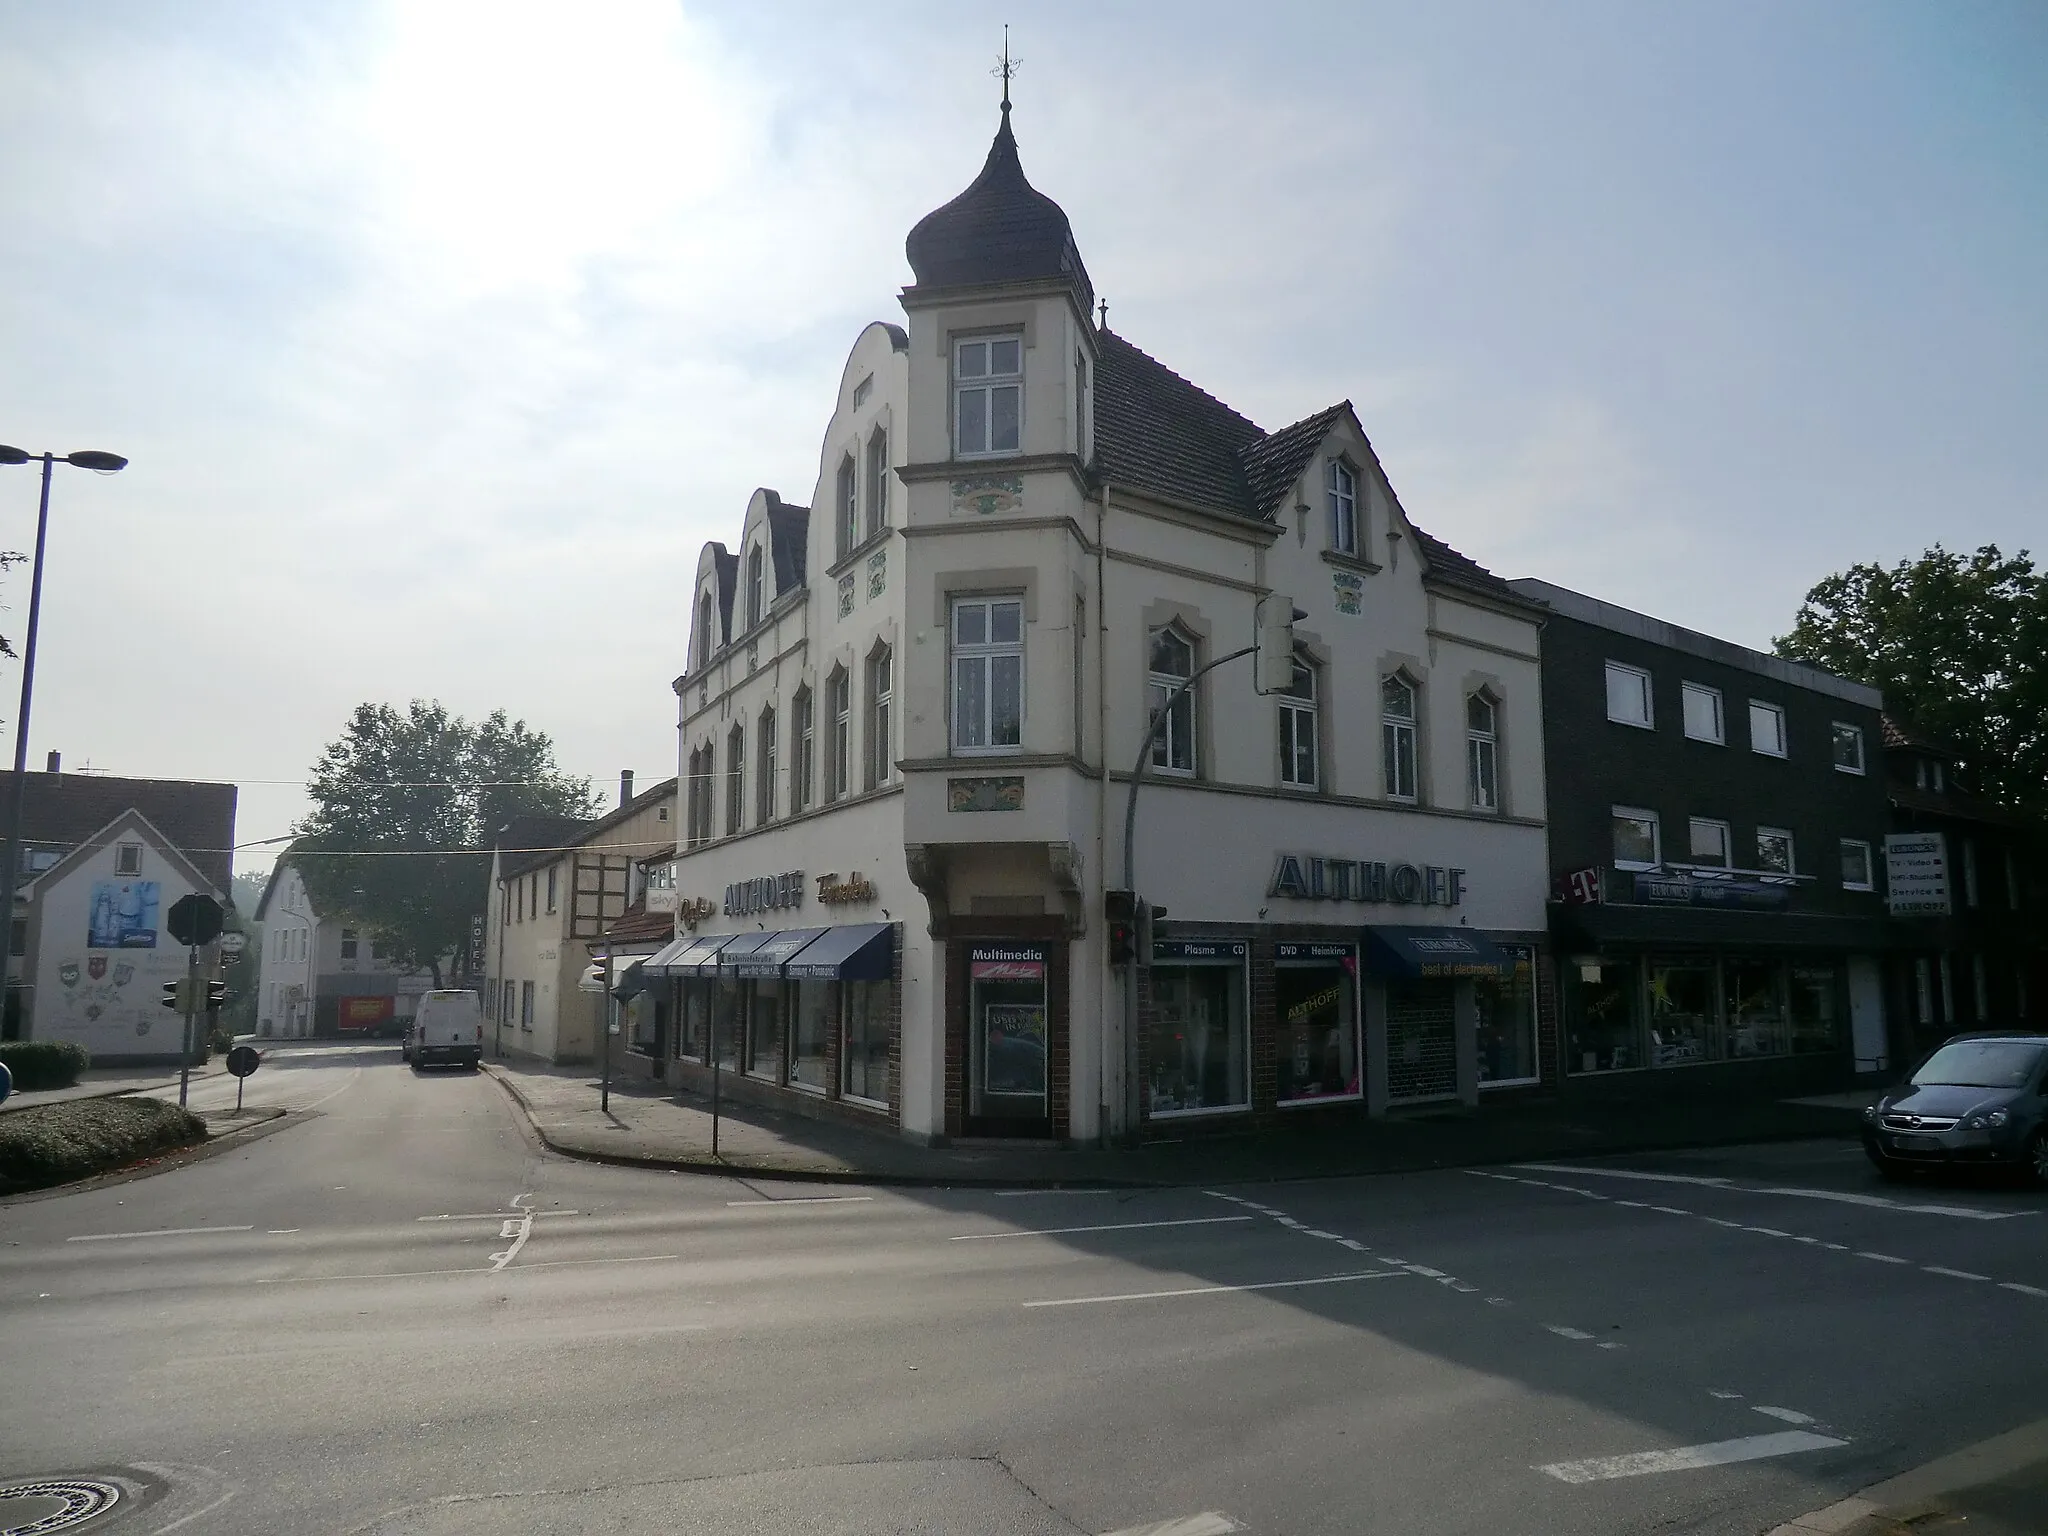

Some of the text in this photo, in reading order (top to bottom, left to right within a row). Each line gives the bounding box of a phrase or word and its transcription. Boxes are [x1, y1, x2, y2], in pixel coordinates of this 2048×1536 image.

[1267, 855, 1466, 907] ALTHOFF
[724, 870, 806, 917] ALTHOFF
[1892, 888, 1932, 896] Service
[651, 895, 672, 909] sky
[472, 915, 483, 972] HOTEL
[1184, 944, 1245, 955] Plasma CD
[1280, 945, 1346, 956] DVD Heimkino
[727, 953, 772, 964] Bahnhofstraße
[972, 949, 1043, 961] Multimedia
[1421, 962, 1441, 976] best
[1443, 962, 1452, 975] of
[1454, 962, 1498, 976] electronics
[1287, 986, 1341, 1020] ALTHOFF
